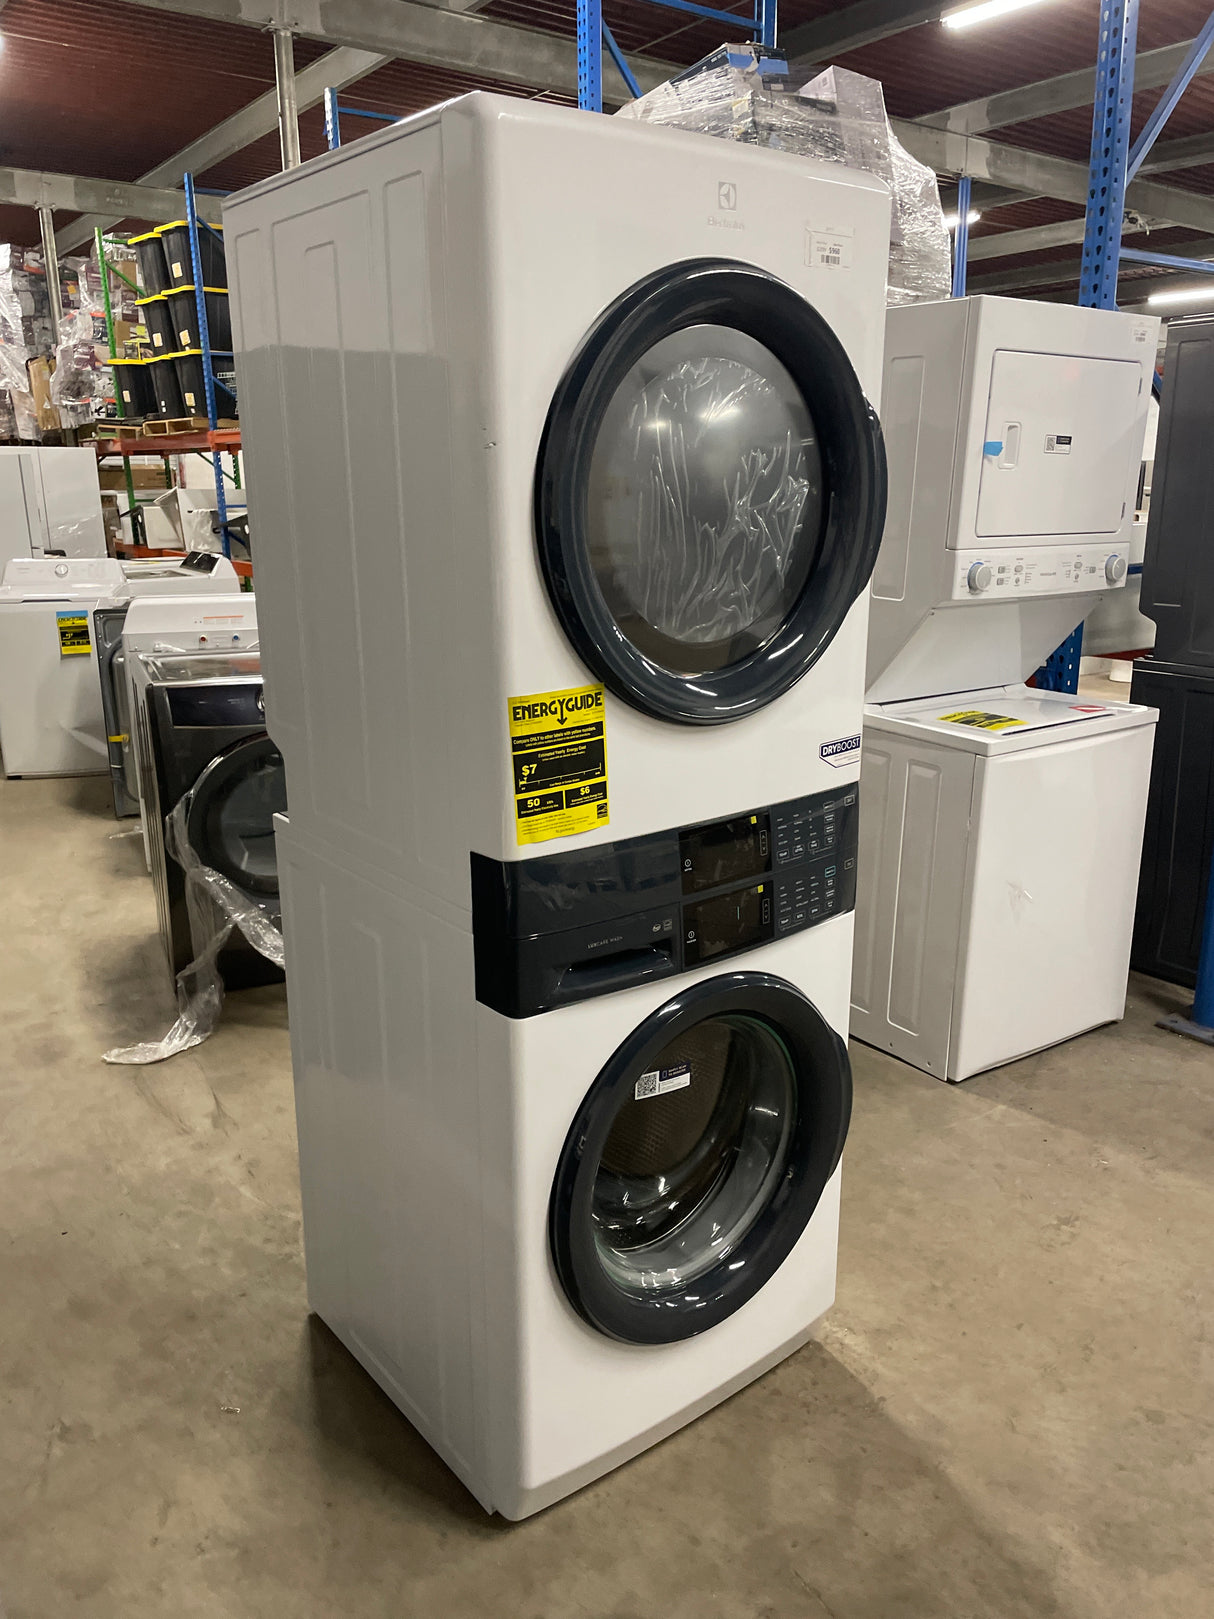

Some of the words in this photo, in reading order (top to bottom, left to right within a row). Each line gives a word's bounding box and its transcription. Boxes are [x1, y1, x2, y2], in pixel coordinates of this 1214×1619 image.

[512, 691, 603, 724] ENERGYGUIDE
[822, 738, 860, 756] DRYBOOST
[521, 763, 537, 776] $7
[580, 786, 590, 796] $6
[527, 798, 540, 808] 50
